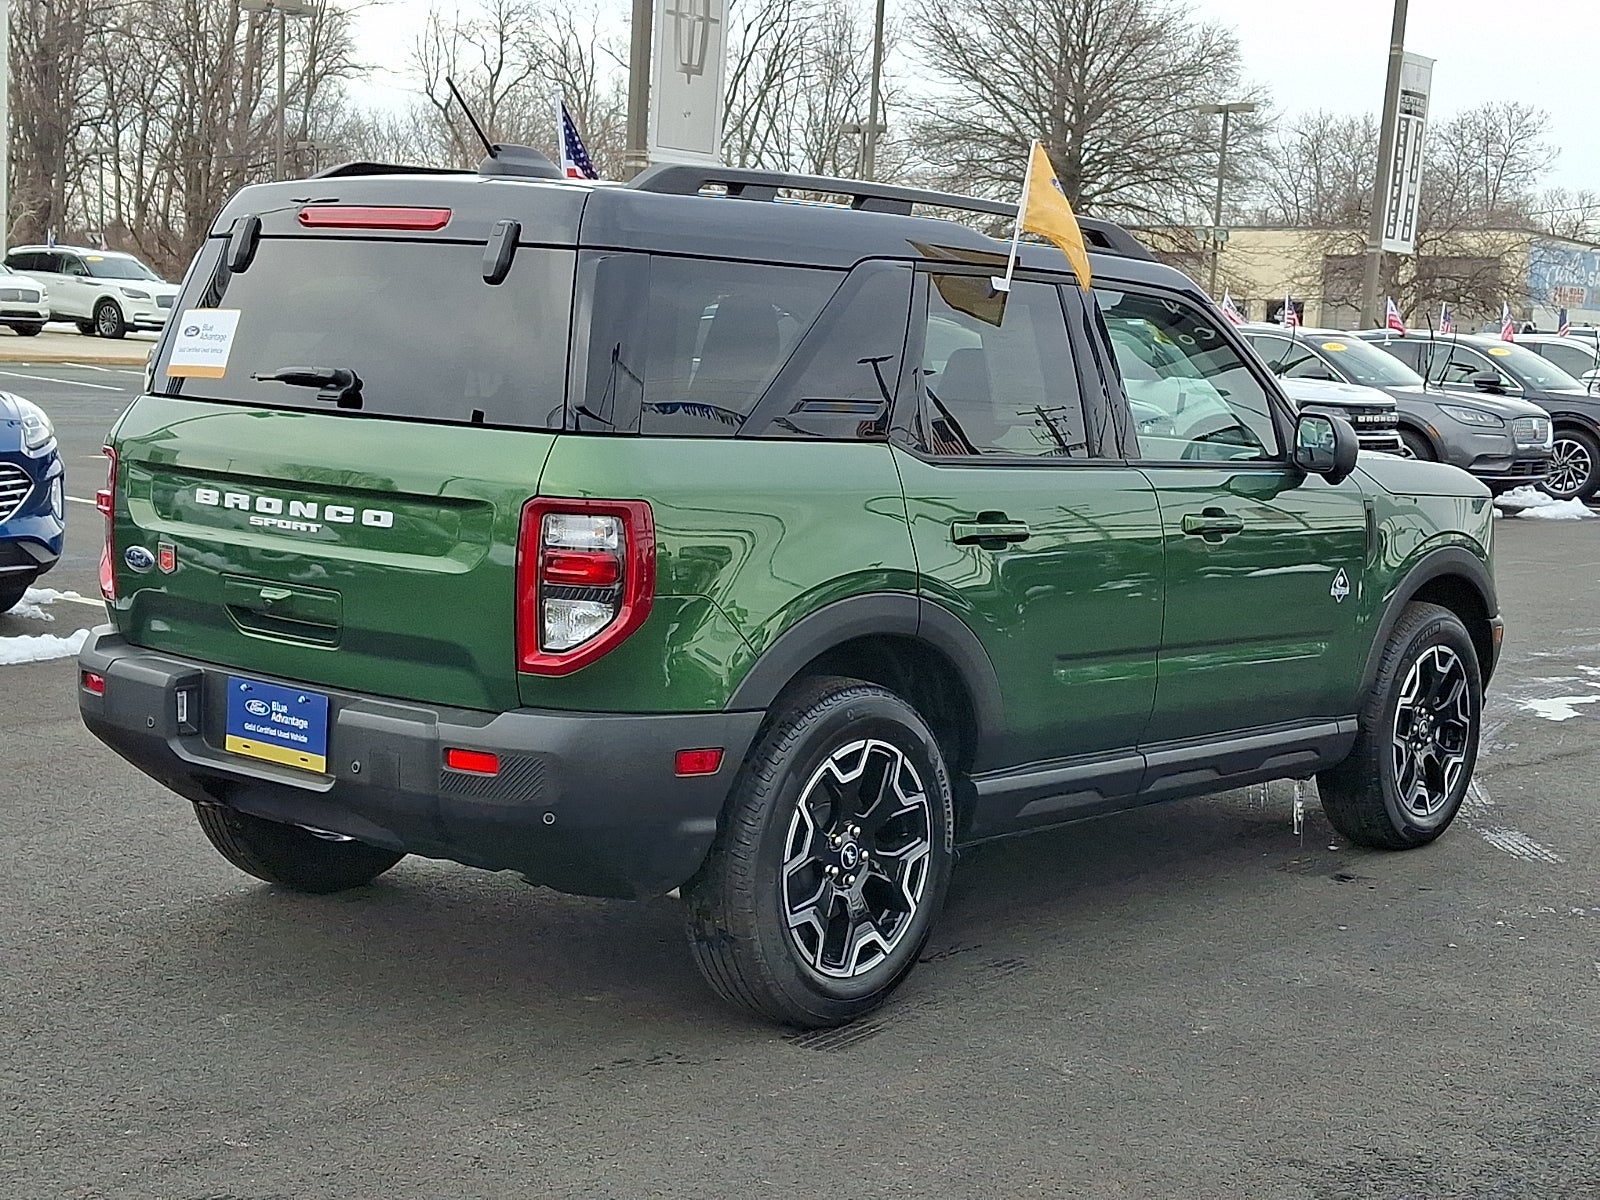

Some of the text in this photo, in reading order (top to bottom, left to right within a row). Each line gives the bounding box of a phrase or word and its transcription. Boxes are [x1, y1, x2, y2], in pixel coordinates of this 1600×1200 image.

[194, 487, 394, 529] BRONCO
[249, 515, 323, 533] SPORT
[248, 701, 268, 714] Ford
[271, 701, 288, 713] Blue
[271, 712, 309, 730] Advantage
[937, 769, 952, 849] MICHELIN
